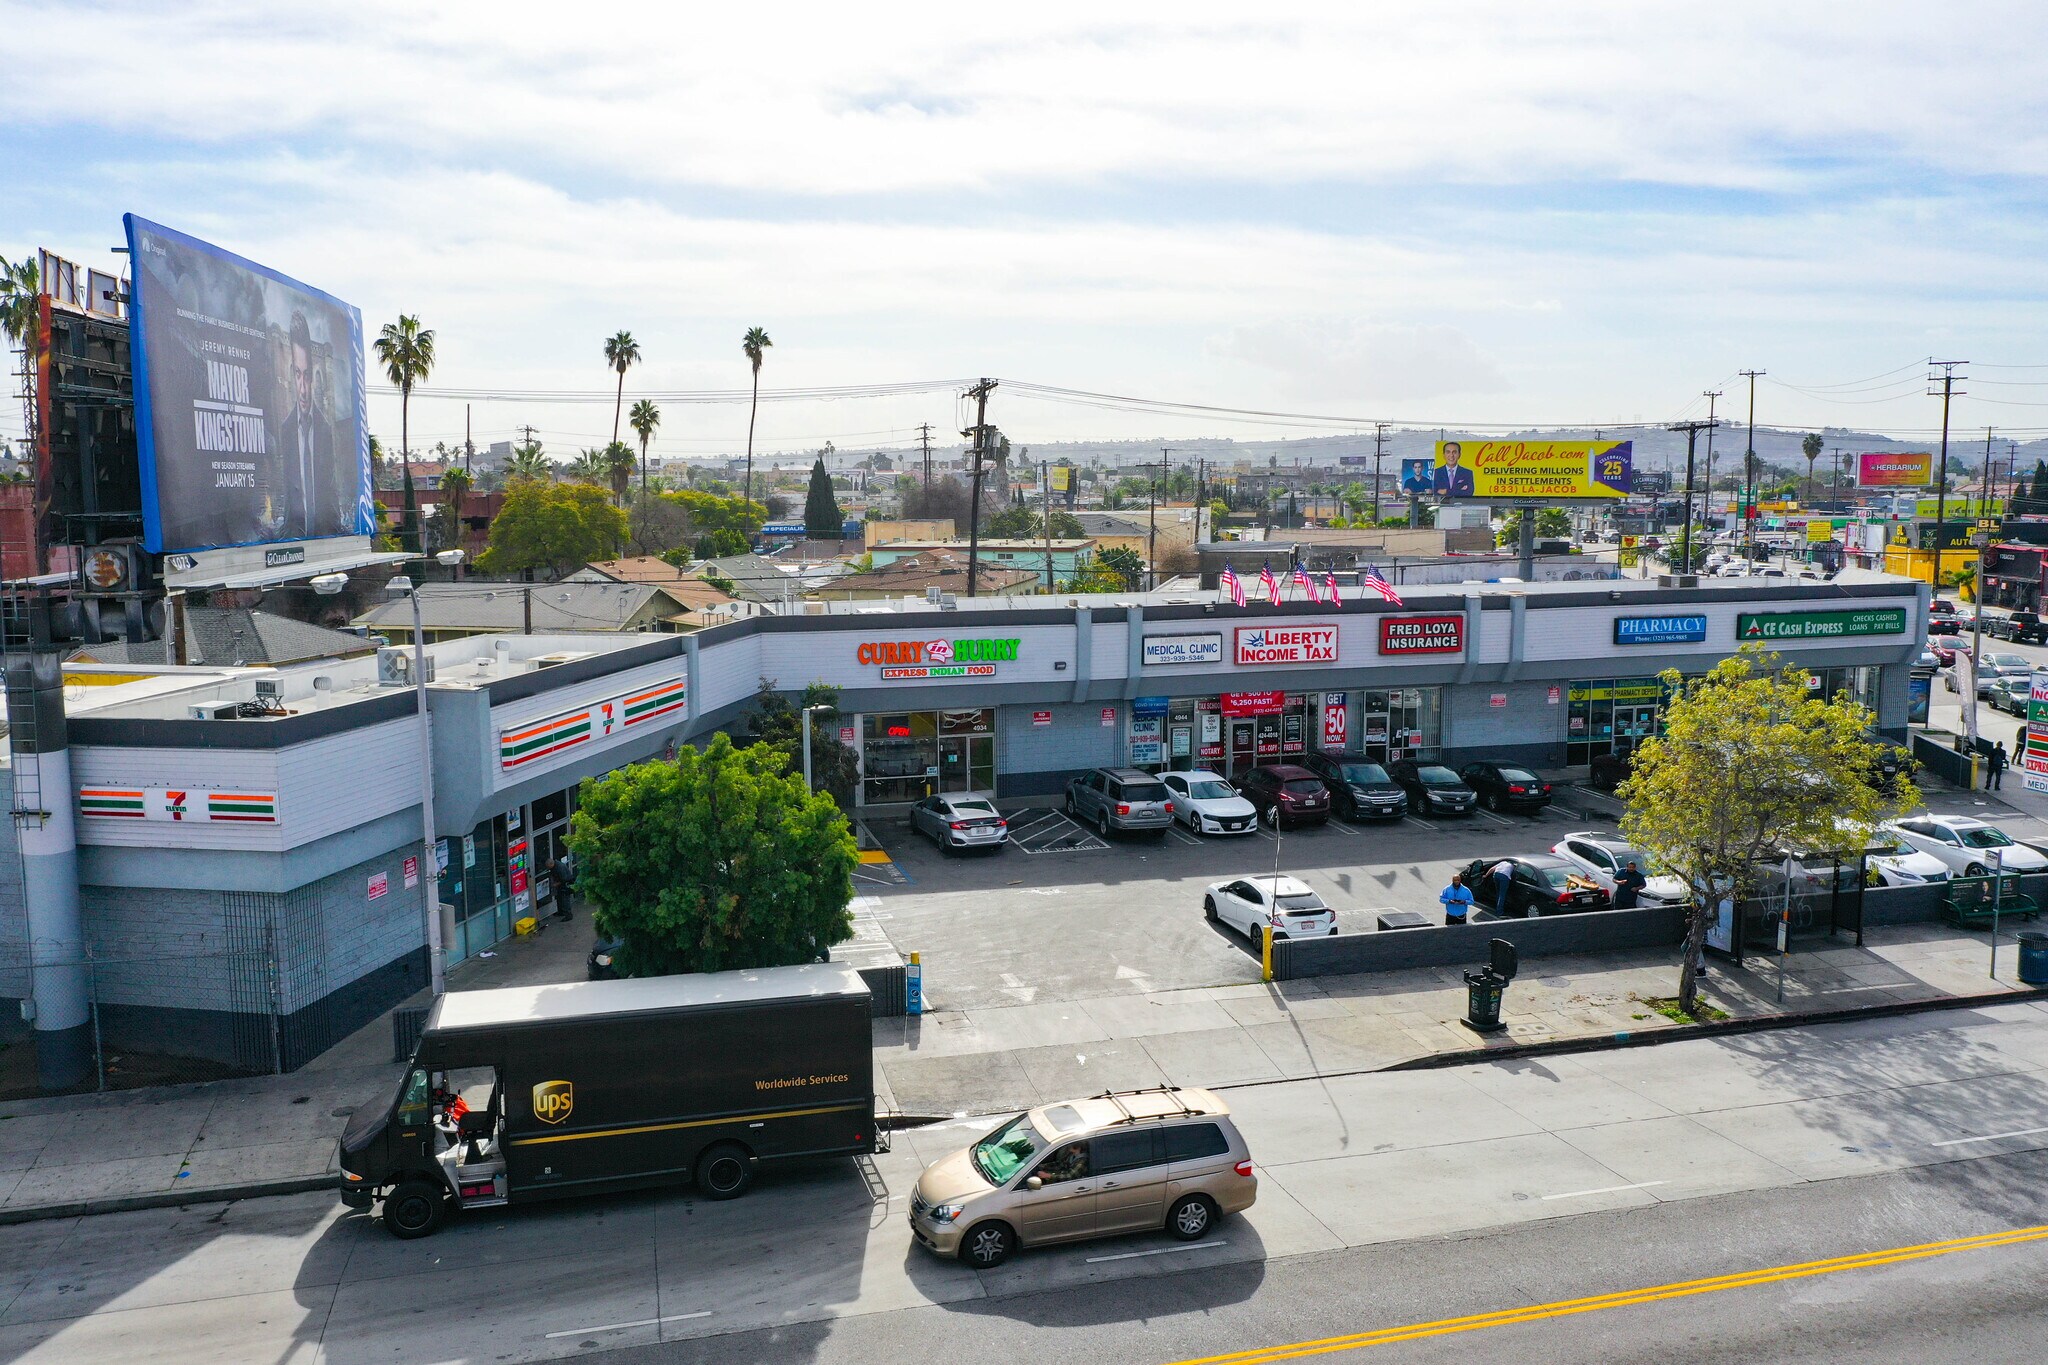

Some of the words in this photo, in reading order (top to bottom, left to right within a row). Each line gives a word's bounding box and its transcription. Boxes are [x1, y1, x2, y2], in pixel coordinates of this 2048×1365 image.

[150, 243, 166, 257] Original
[177, 308, 196, 320] RUNNING
[196, 314, 204, 322] THE
[205, 316, 218, 326] FAMILY
[218, 320, 235, 331] BUSINESS
[201, 340, 226, 355] JEREMY
[227, 345, 251, 360] RENNER
[207, 360, 250, 404] MAYOR
[229, 404, 235, 412] OF
[194, 410, 266, 454] KINGSTOWN
[1475, 442, 1510, 467] Call
[1598, 455, 1629, 465] CELEBRATING
[212, 461, 221, 469] NEW
[221, 461, 236, 470] SEASON
[236, 462, 256, 471] STREAMING
[1483, 467, 1538, 475] DELIVERING
[1603, 461, 1622, 475] 25
[215, 473, 247, 488] JANUARY
[247, 473, 255, 488] 15
[1489, 485, 1519, 494] (833)
[1522, 485, 1577, 493] LA-JACOB
[1979, 519, 2000, 528] BL
[1389, 624, 1421, 635] FRED
[1425, 623, 1456, 634] LOYA
[1621, 617, 1704, 633] PHARMACY
[1885, 622, 1900, 630] BILLS
[1386, 636, 1458, 649] INSURANCE
[857, 640, 925, 665] CURRY
[930, 643, 948, 653] in
[952, 638, 1022, 662] HURRY
[1146, 644, 1186, 656] MEDICAL
[1189, 643, 1218, 654] CLINIC
[1160, 654, 1205, 662] 323-939-5346
[884, 668, 928, 678] EXPRESS
[929, 667, 965, 676] INDIAN
[967, 666, 994, 675] FOOD
[1327, 693, 1344, 704] GET
[1613, 689, 1640, 697] PHARMACY
[1641, 688, 1658, 696] DEPOT
[1230, 698, 1253, 707] $6,250
[1325, 707, 1345, 734] $50
[887, 725, 912, 737] OPEN
[1133, 722, 1155, 732] CLINIC
[1200, 747, 1221, 755] NOTARY
[166, 791, 186, 821] 7
[755, 1077, 807, 1090] Worldwide
[809, 1073, 849, 1085] Services
[536, 1092, 571, 1118] ups
